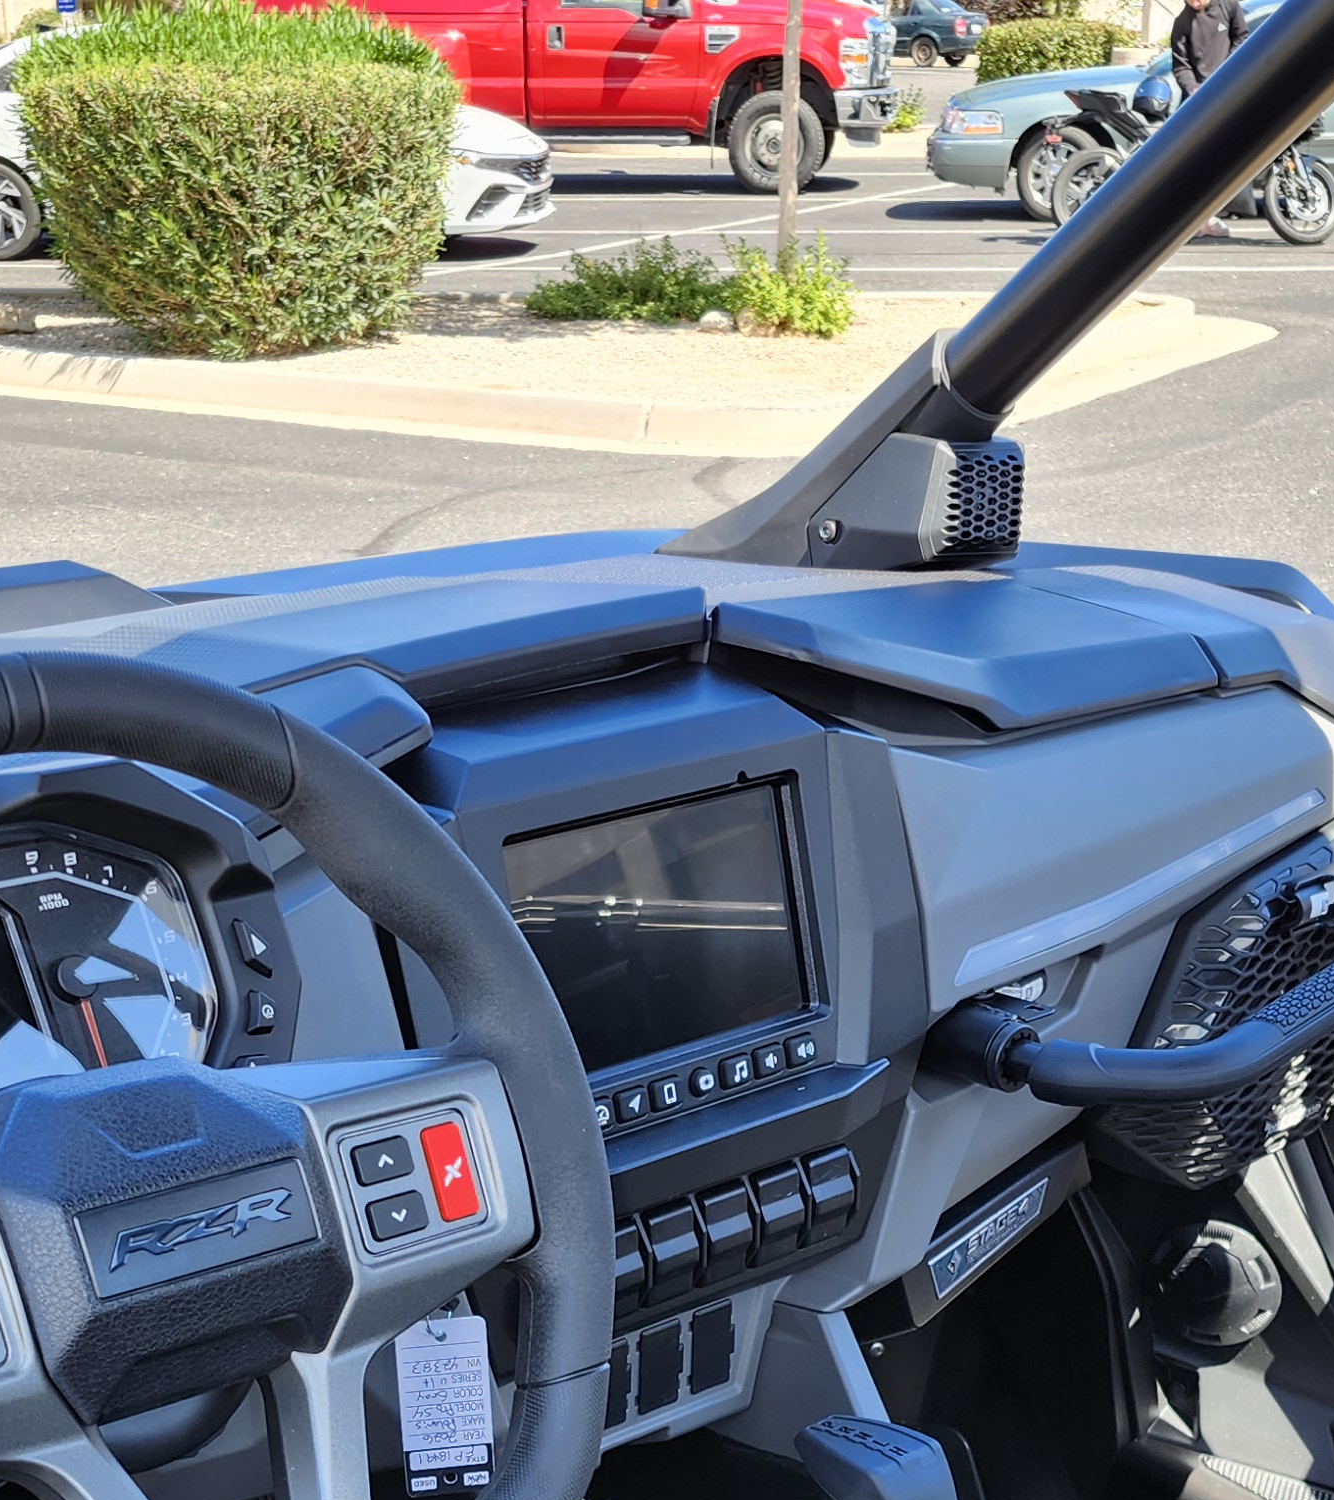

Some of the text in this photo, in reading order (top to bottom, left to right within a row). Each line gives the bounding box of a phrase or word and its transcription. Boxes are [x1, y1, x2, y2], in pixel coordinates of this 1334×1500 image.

[25, 851, 38, 866] 9
[63, 852, 78, 866] 8
[145, 881, 158, 894] 6
[39, 892, 63, 904] RPM
[164, 930, 176, 943] 5
[181, 1012, 192, 1026] 3
[109, 1187, 293, 1273] RZR
[467, 1358, 481, 1367] VIN
[451, 1373, 482, 1383] SERIES
[454, 1387, 483, 1398] COLOR
[455, 1402, 484, 1412] MODEL
[415, 1417, 485, 1429] MAKE Polaris
[463, 1430, 486, 1440] YEAR
[413, 1479, 435, 1487] USED
